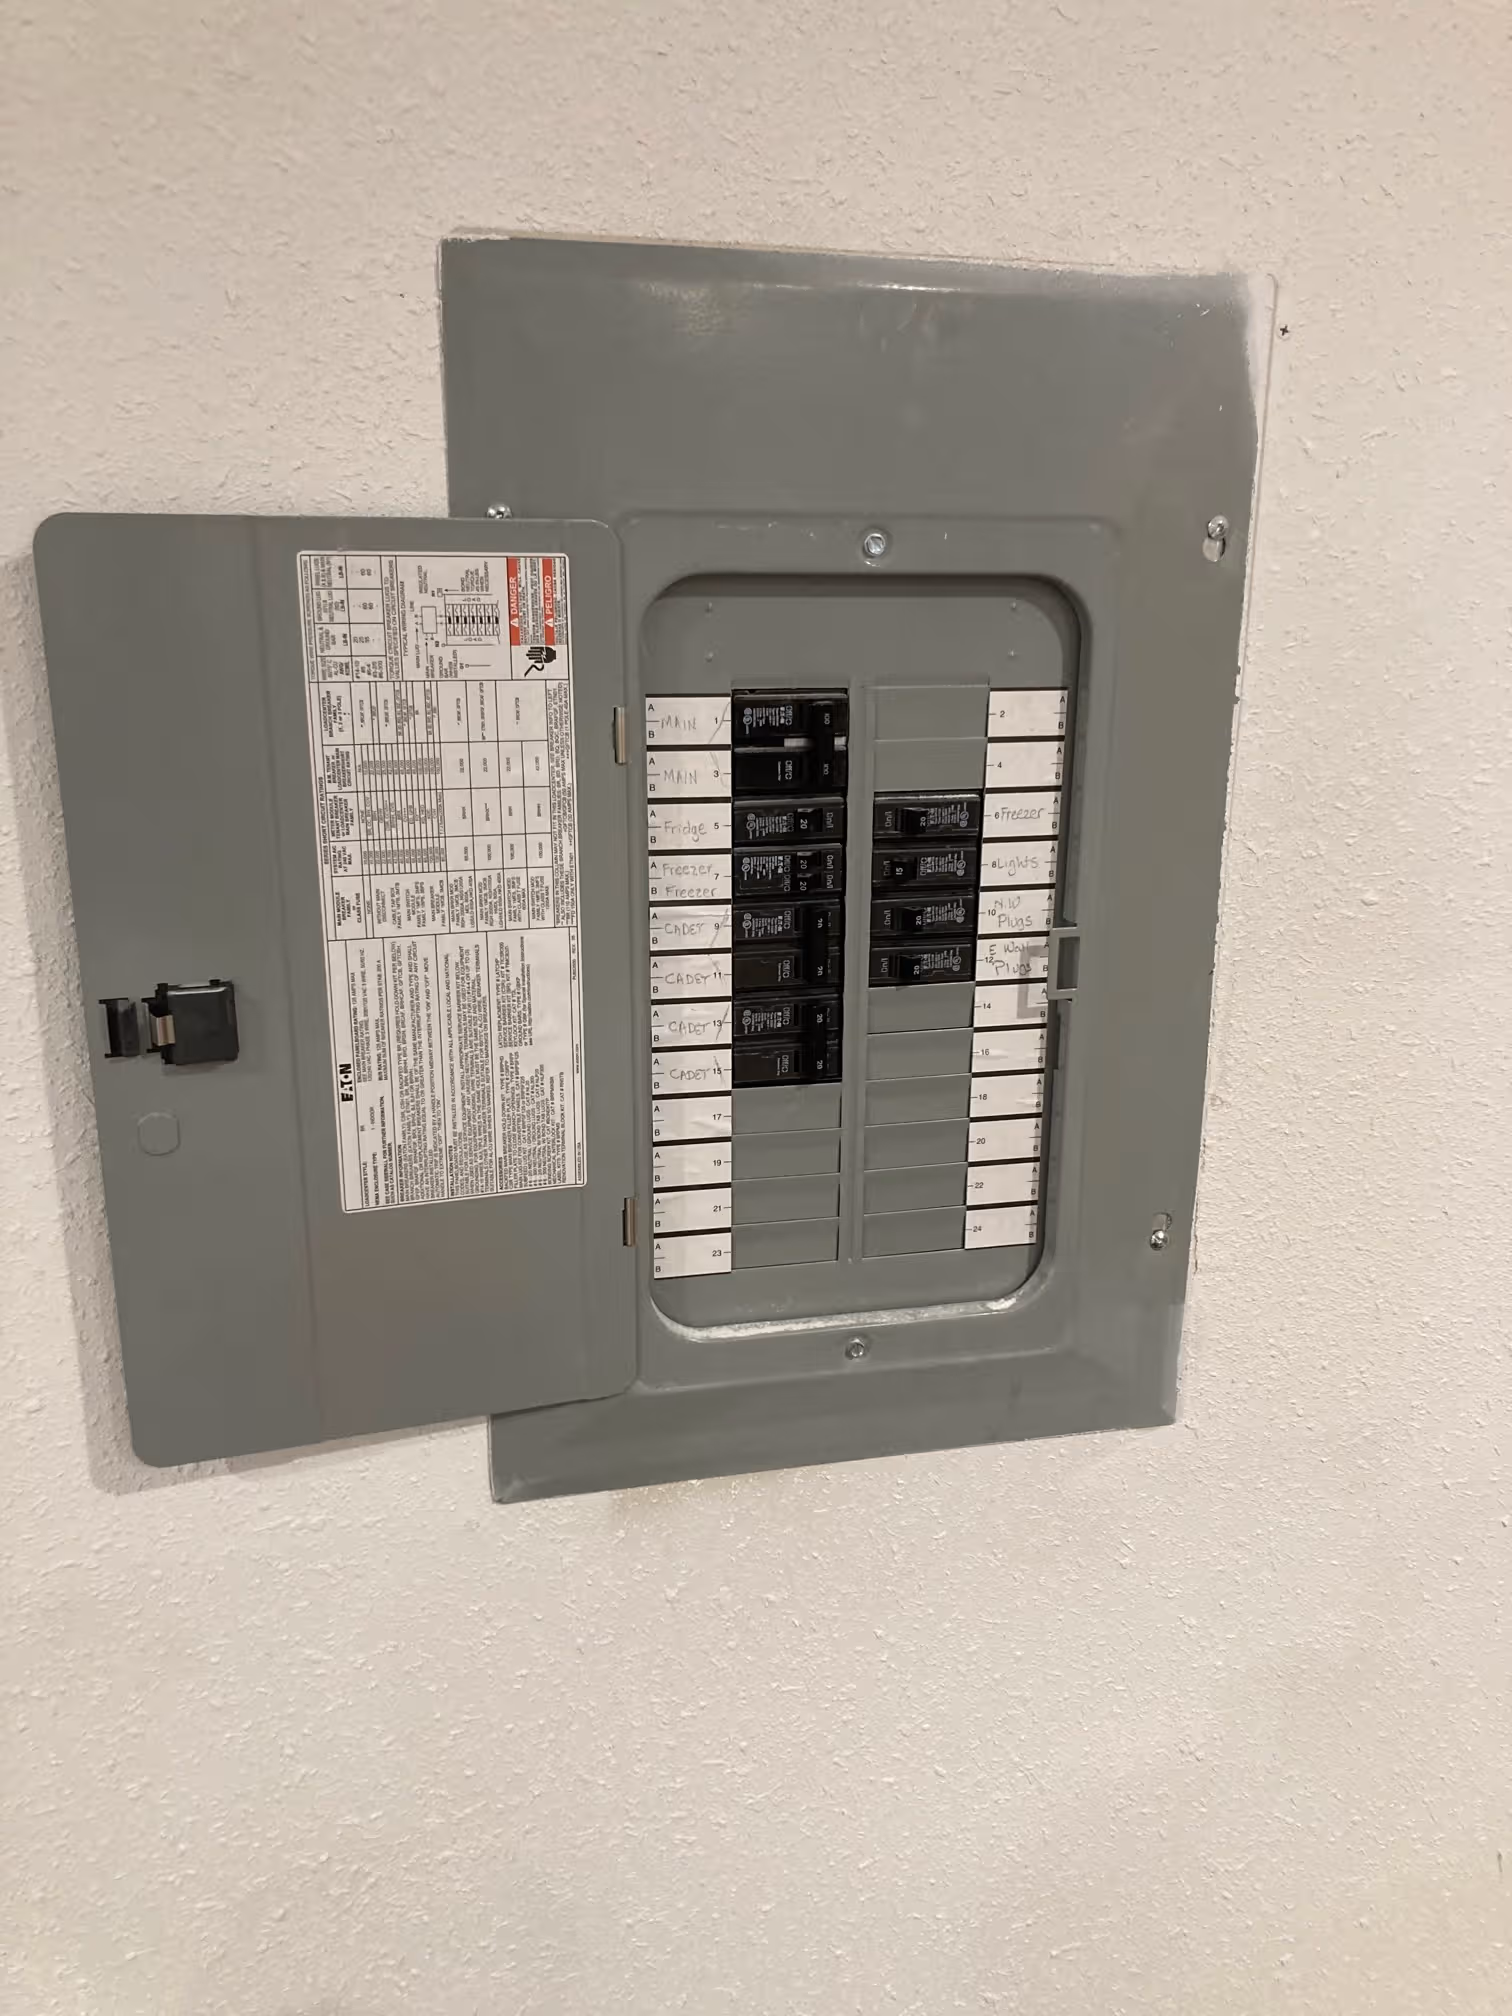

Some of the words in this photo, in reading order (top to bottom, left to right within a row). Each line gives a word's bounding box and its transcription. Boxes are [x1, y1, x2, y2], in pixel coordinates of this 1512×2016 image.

[384, 577, 389, 585] TO
[509, 577, 518, 614] DANGER
[544, 575, 553, 614] PELIGRO
[392, 616, 397, 625] ON
[1060, 695, 1065, 704] A
[648, 704, 655, 712] A
[661, 714, 696, 731] MAIN
[1058, 721, 1064, 730] B
[648, 730, 655, 738] B
[649, 757, 655, 765] A
[664, 768, 697, 784] MAIN
[714, 770, 719, 778] 3
[1055, 772, 1061, 780] B
[649, 784, 656, 792] B
[650, 810, 656, 818] A
[1001, 807, 1046, 821] Freezer
[714, 822, 719, 830] 5
[800, 819, 808, 829] 20
[920, 816, 926, 827] 20
[1052, 821, 1058, 829] B
[664, 820, 707, 842] Fridge
[650, 836, 656, 844] B
[650, 861, 657, 869] A
[800, 860, 807, 869] 20
[997, 856, 1039, 876] Lights
[896, 867, 903, 875] 15
[1049, 869, 1055, 878] B
[800, 881, 807, 891] 20
[651, 887, 657, 895] B
[666, 885, 718, 898] Freezer
[652, 912, 658, 920] A
[916, 915, 922, 925] 20
[998, 914, 1032, 931] Plugs
[664, 922, 705, 936] CADET
[652, 936, 658, 944] B
[989, 944, 996, 956] E
[1004, 941, 1029, 953] Wall
[985, 956, 994, 964] 12
[914, 965, 920, 975] 20
[993, 960, 1032, 976] Plugs
[665, 972, 712, 985] CADET
[652, 986, 659, 994] B
[653, 1010, 659, 1018] A
[816, 1014, 823, 1023] 20
[1040, 1010, 1046, 1018] B
[669, 1020, 711, 1035] CADET
[653, 1058, 660, 1066] A
[816, 1060, 823, 1069] 20
[670, 1068, 711, 1080] CADET
[339, 1063, 353, 1102] EATON
[1034, 1122, 1040, 1130] A
[1033, 1144, 1039, 1152] B
[1031, 1188, 1036, 1196] B
[655, 1220, 661, 1228] B
[1029, 1230, 1034, 1238] B
